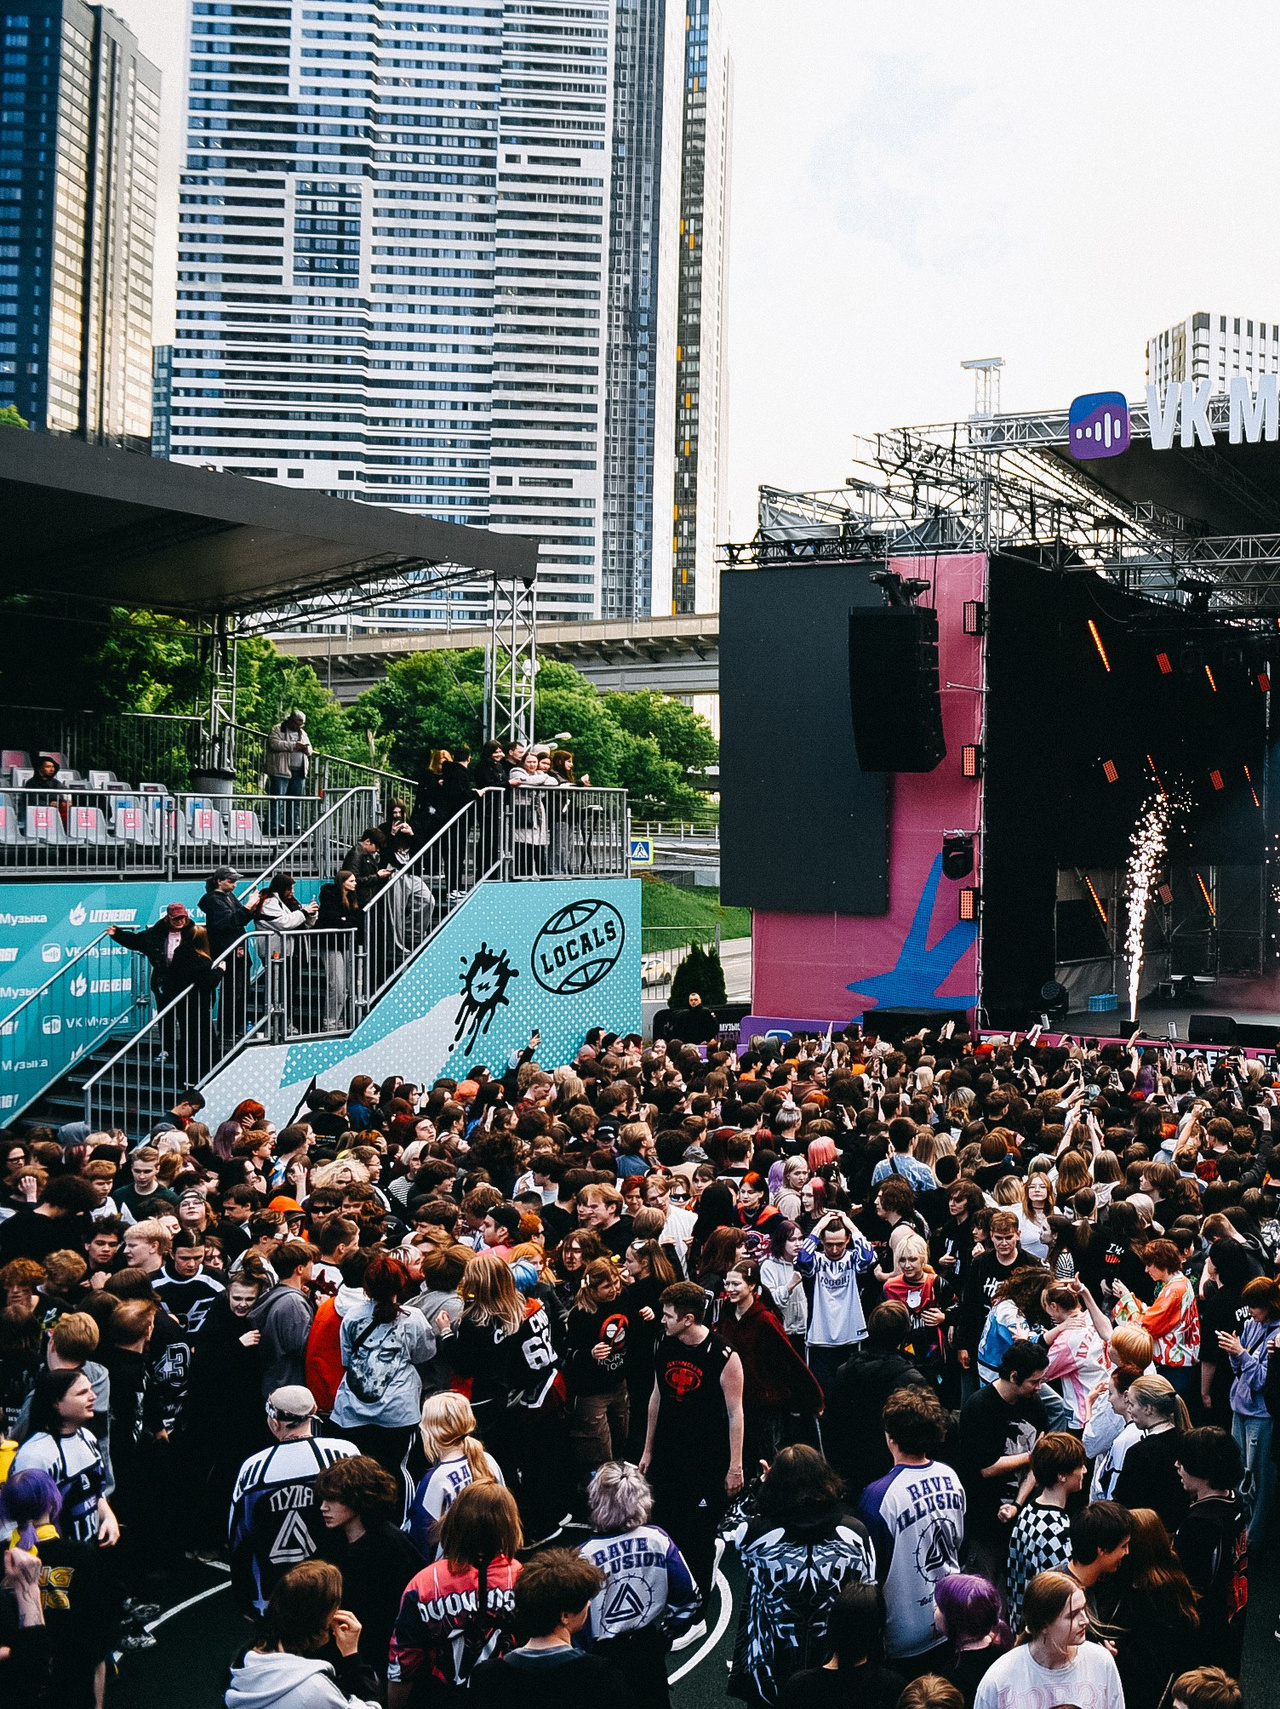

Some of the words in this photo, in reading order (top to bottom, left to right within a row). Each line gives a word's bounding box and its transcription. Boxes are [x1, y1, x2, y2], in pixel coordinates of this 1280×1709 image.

[1146, 380, 1216, 450] VK
[0, 913, 47, 926] Музыка
[89, 909, 137, 922] LITENERGY
[540, 920, 617, 975] LOCALS
[90, 978, 132, 993] LITENERG
[906, 1476, 954, 1502] RAVE
[593, 1537, 648, 1567] RAVE
